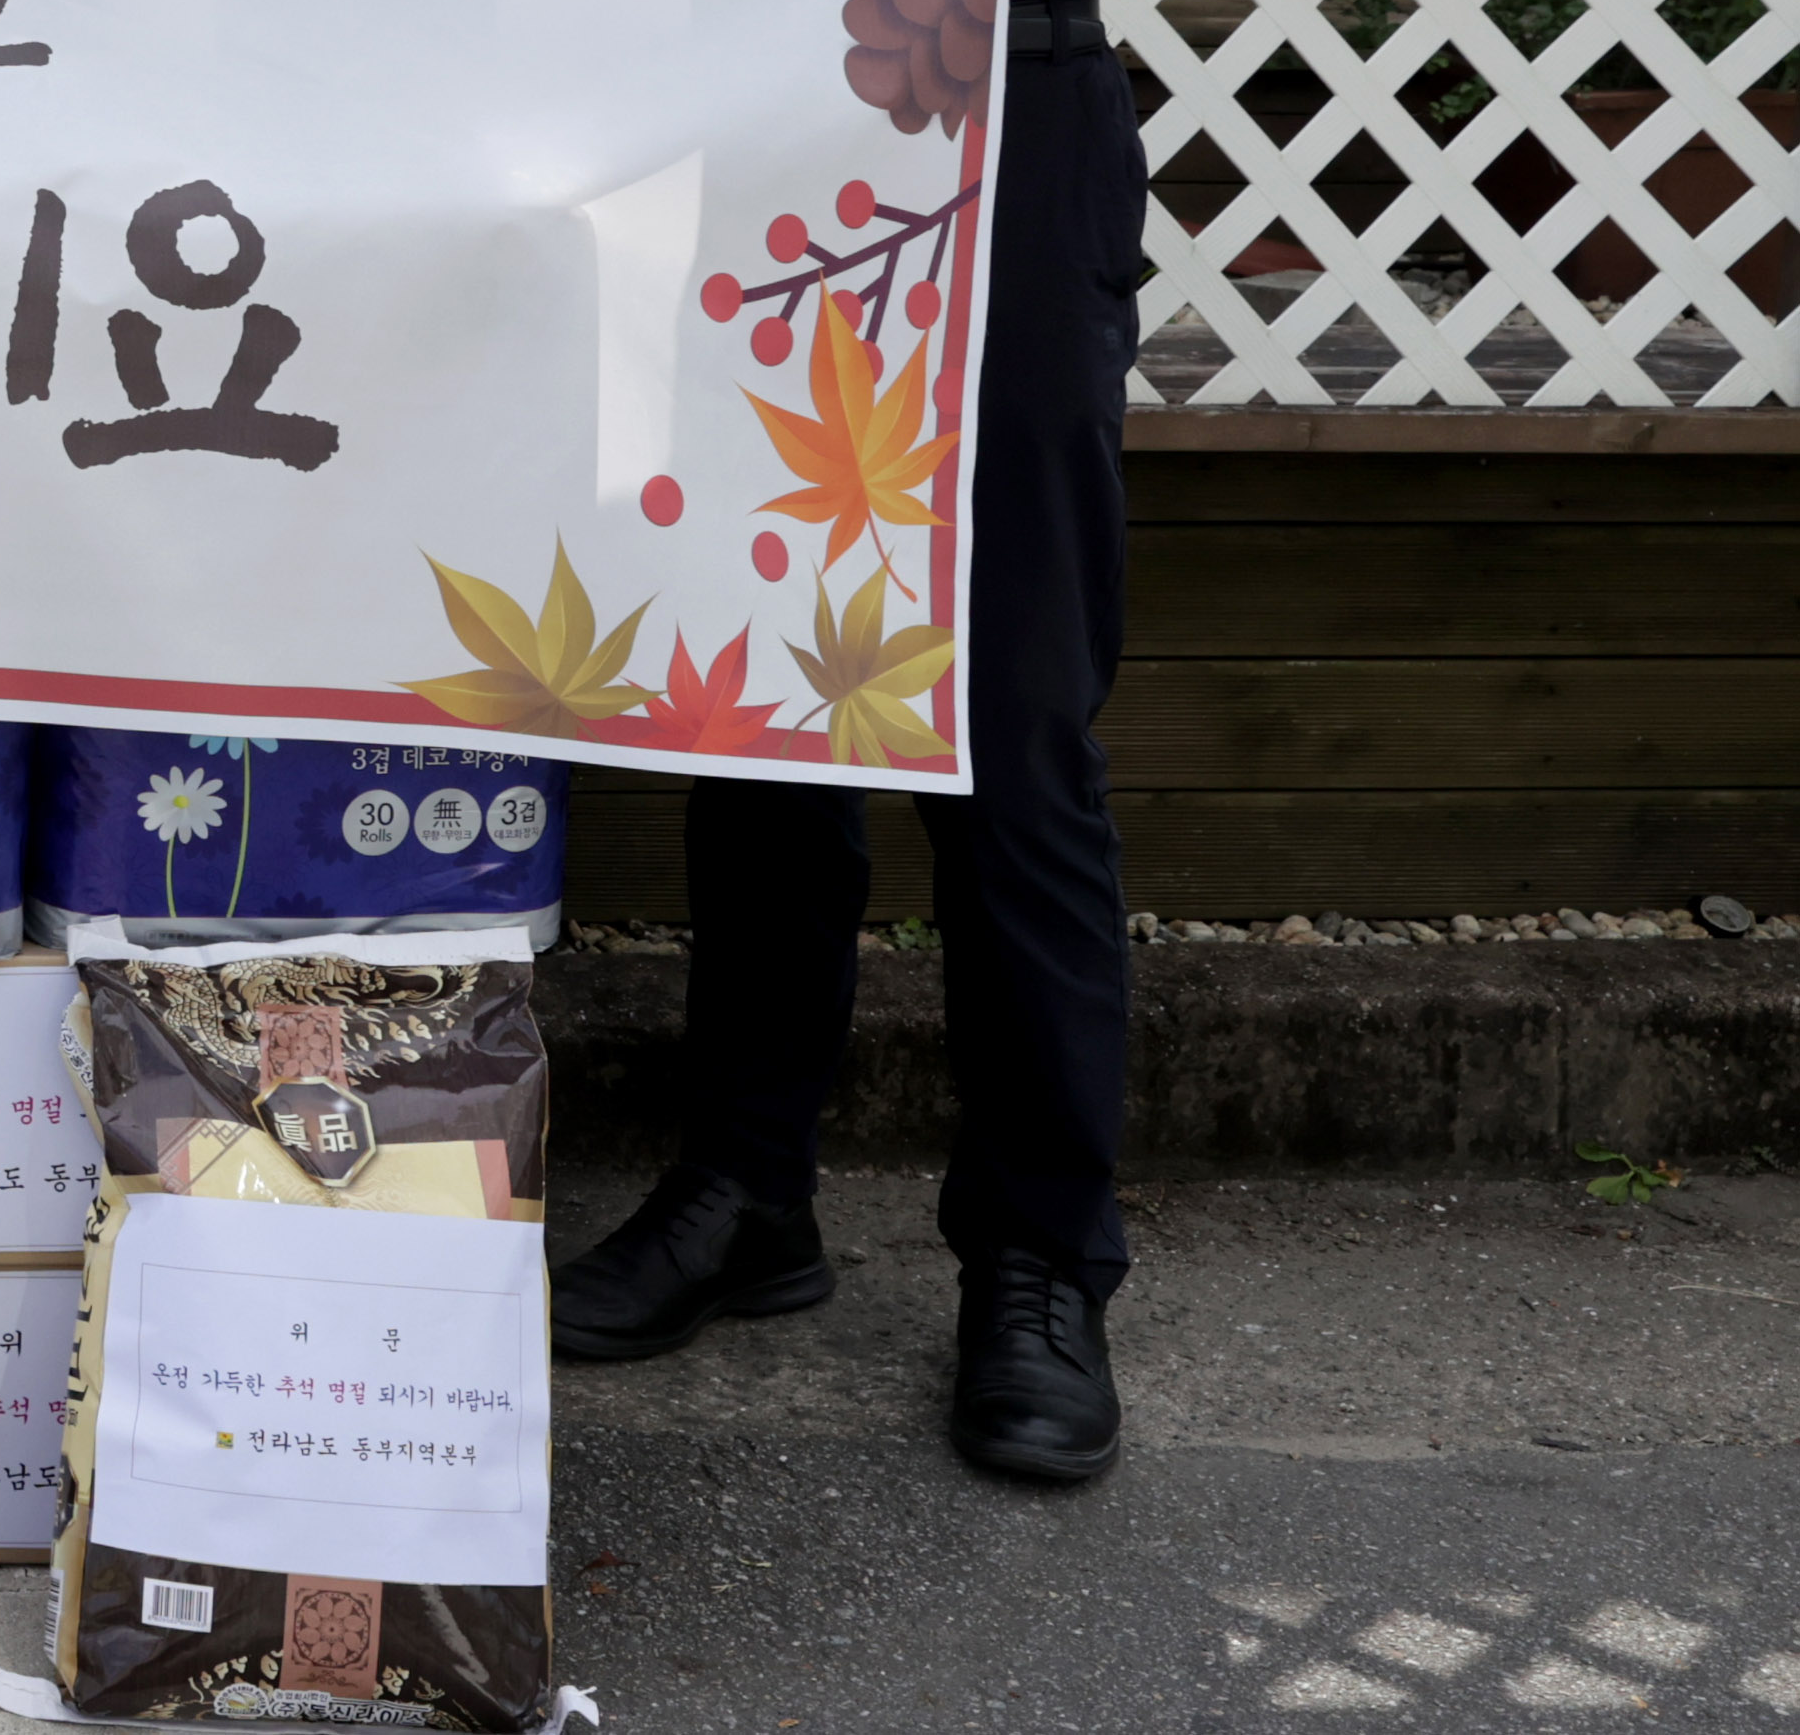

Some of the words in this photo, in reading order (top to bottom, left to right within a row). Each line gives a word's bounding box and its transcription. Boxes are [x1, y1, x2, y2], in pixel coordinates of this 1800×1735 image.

[351, 746, 391, 775] 3겹
[402, 745, 451, 770] 데코
[359, 802, 395, 827] 30
[433, 798, 462, 828] 無
[501, 799, 537, 825] 3겹
[359, 828, 393, 843] Rolls
[10, 1094, 64, 1127] 명절
[151, 1362, 189, 1390] 온정
[201, 1370, 266, 1394] 가득한
[274, 1373, 316, 1402] 추석
[328, 1378, 368, 1406] 명절
[377, 1383, 436, 1408] 되시기
[445, 1387, 514, 1414] 바랍니다.
[246, 1428, 339, 1458] 전라남도
[351, 1436, 478, 1466] 동부지역본부
